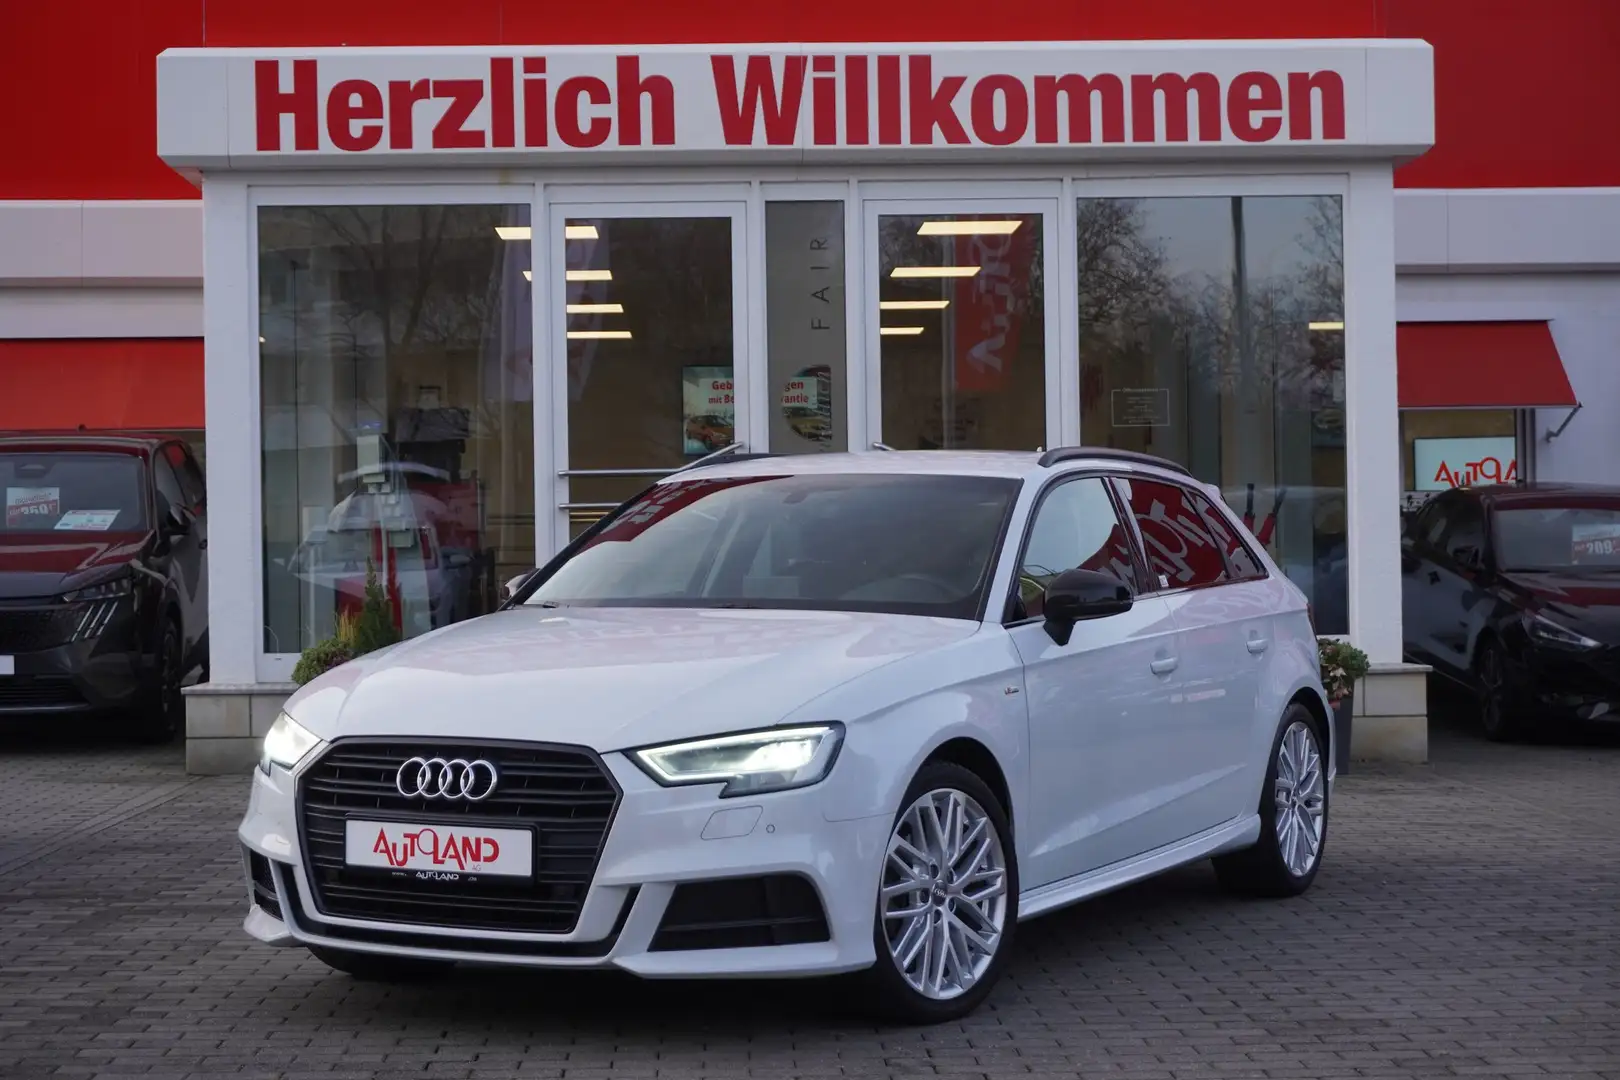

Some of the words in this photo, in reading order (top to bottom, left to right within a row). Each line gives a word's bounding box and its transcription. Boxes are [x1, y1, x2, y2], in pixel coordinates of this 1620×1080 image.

[254, 55, 675, 152] Herzlich
[711, 54, 1346, 147] Willkommen
[811, 237, 831, 330] FAIR
[373, 827, 500, 871] AUTOLAND
[471, 864, 482, 872] AG
[415, 870, 460, 881] AUTOLAND
